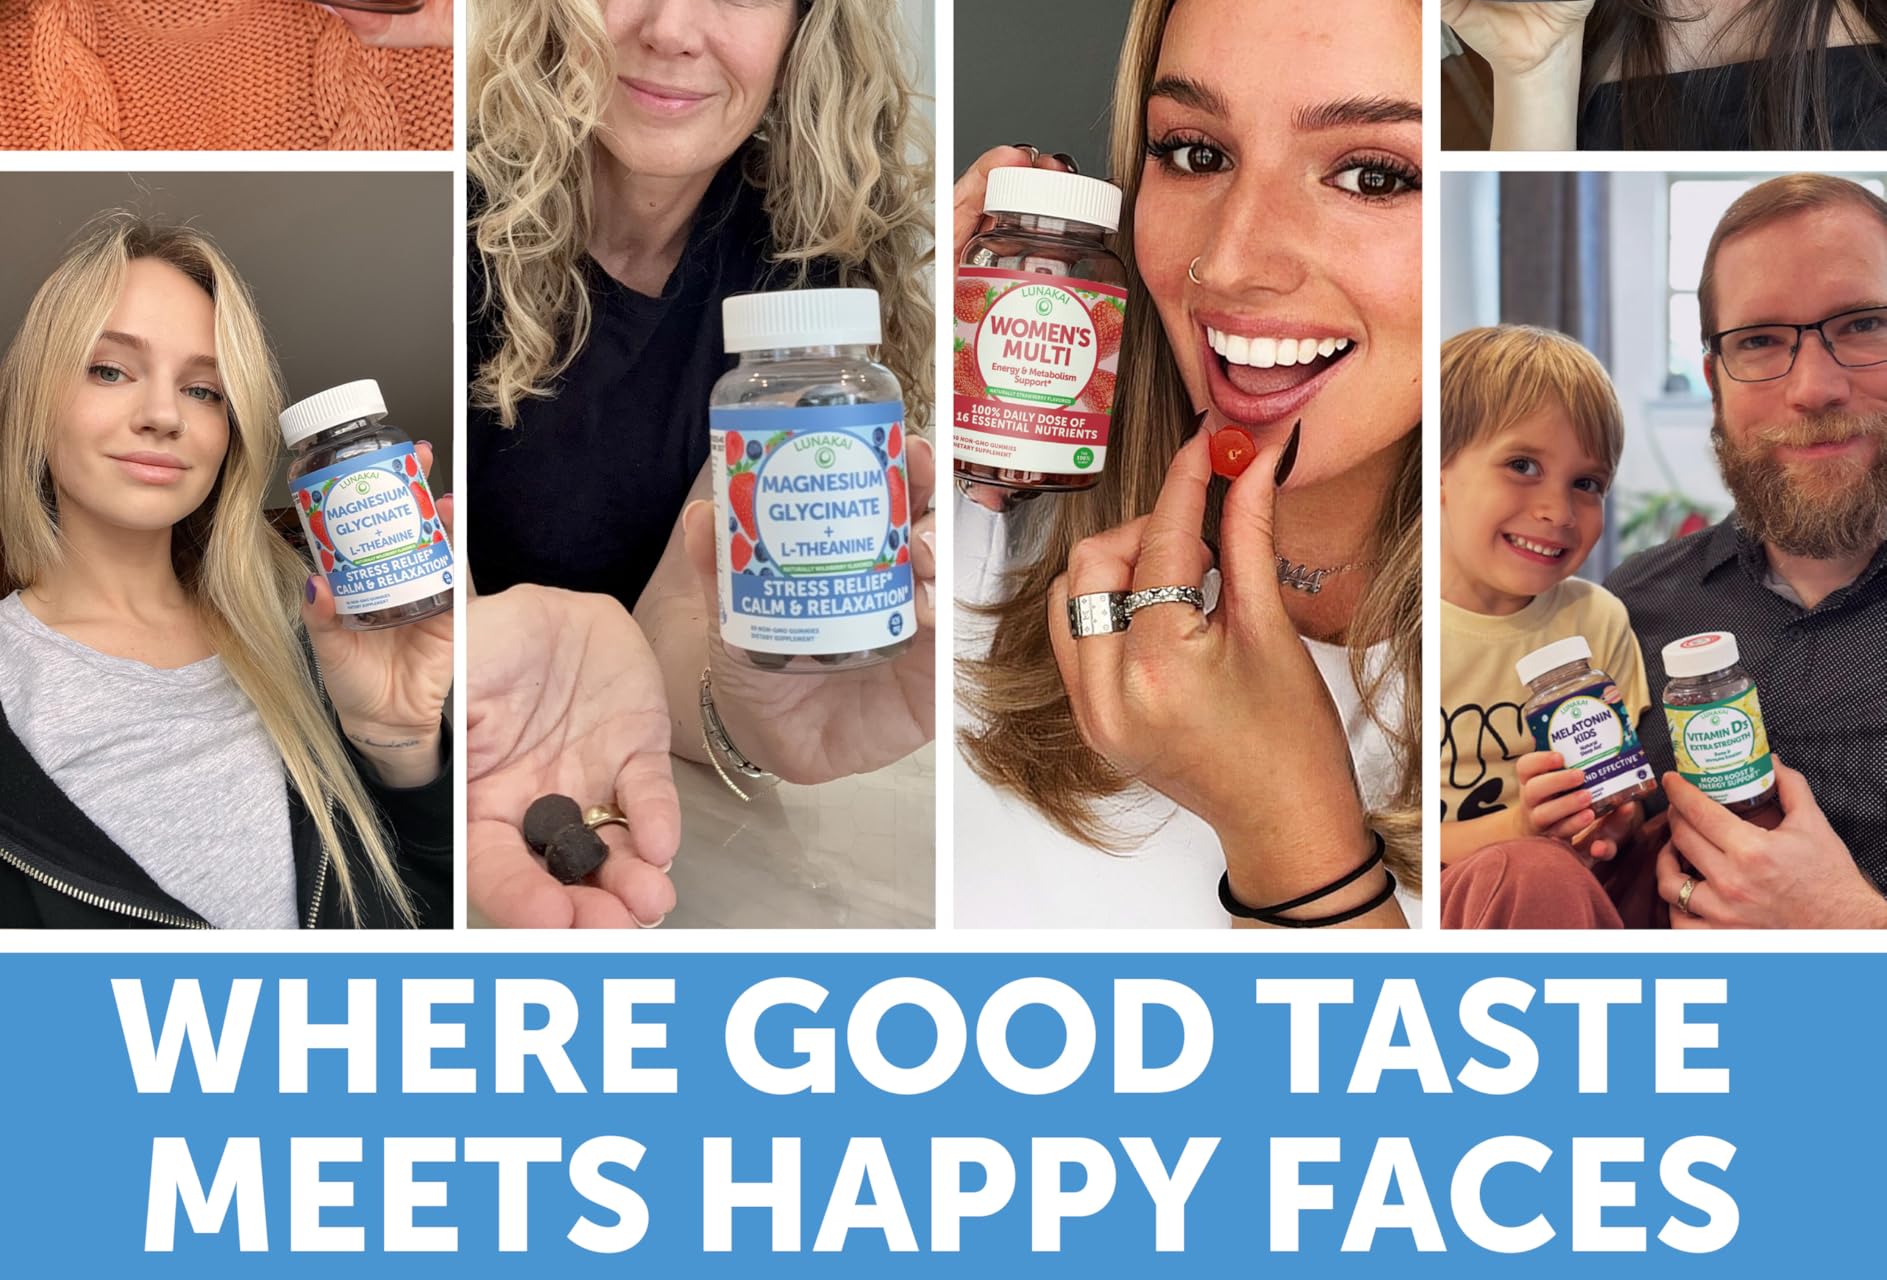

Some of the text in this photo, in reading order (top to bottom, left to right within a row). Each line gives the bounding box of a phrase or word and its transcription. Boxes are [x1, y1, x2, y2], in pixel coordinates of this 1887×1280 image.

[1021, 287, 1070, 305] LUNAKAI
[990, 315, 1091, 348] WOMEN'S
[1003, 339, 1071, 367] MULTI
[992, 362, 1077, 382] Energy & Metabolism
[972, 404, 1086, 428] 100% DAILY DOSE OF
[956, 412, 1098, 440] 16 ESSENTIAL NUTRIENTS
[794, 435, 852, 452] LUNAKAI
[961, 436, 989, 447] NON-GMO
[990, 442, 1016, 452] GUMMIES
[975, 447, 1012, 458] SUPPLEMENT
[340, 472, 380, 489] LUNAKAI
[762, 470, 883, 494] MAGNESIUM
[327, 486, 409, 520] MAGNESIUM
[769, 498, 880, 521] GLYCINATE
[336, 505, 412, 536] GLYCINATE
[824, 526, 834, 537] +
[350, 531, 414, 555] L-THEANINE
[782, 537, 874, 557] L-THEANINE
[346, 563, 389, 582] STRESS
[337, 582, 364, 595] CALM
[367, 580, 374, 589] &
[764, 580, 829, 597] STRESS
[742, 597, 785, 615] CALM
[790, 600, 802, 616] &
[1552, 710, 1612, 742] MELATONIN
[1687, 728, 1730, 741] VITAMIN
[1574, 729, 1597, 744] KIDS
[1714, 732, 1751, 749] STRENGTH
[1598, 754, 1638, 775] EFFECTIVE
